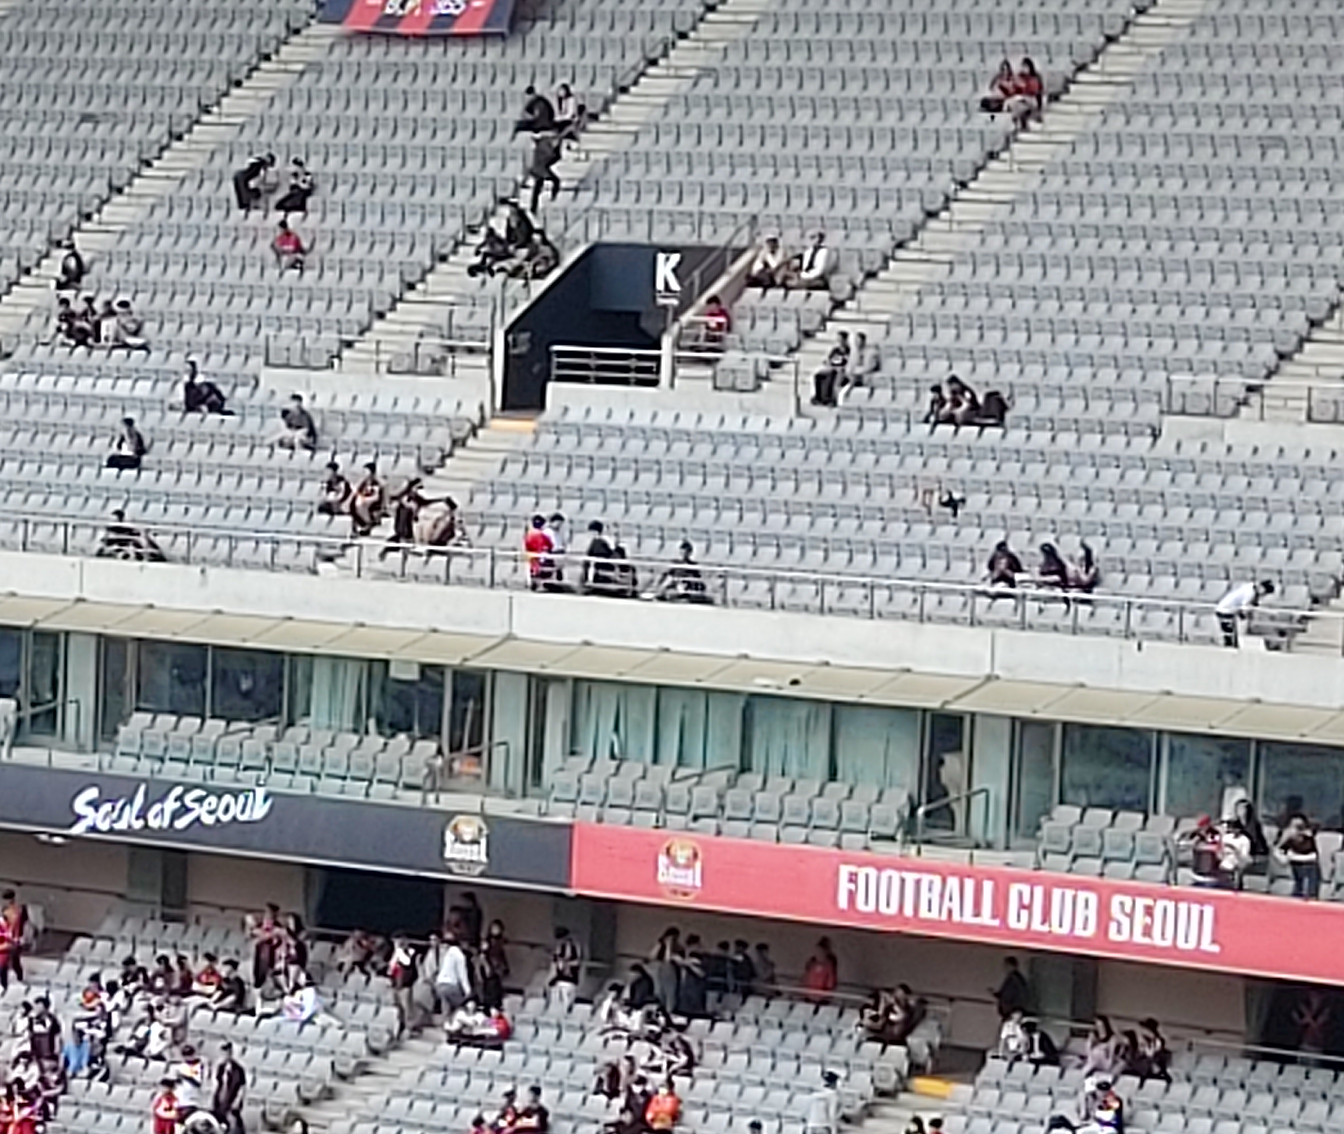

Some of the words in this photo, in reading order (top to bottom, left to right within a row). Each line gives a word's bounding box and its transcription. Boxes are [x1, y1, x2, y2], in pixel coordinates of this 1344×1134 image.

[656, 253, 681, 292] K
[174, 782, 273, 829] Seoul
[837, 863, 1000, 927] FOOTBALL
[1007, 883, 1098, 937] CLUB
[1108, 894, 1220, 953] SEOUL
